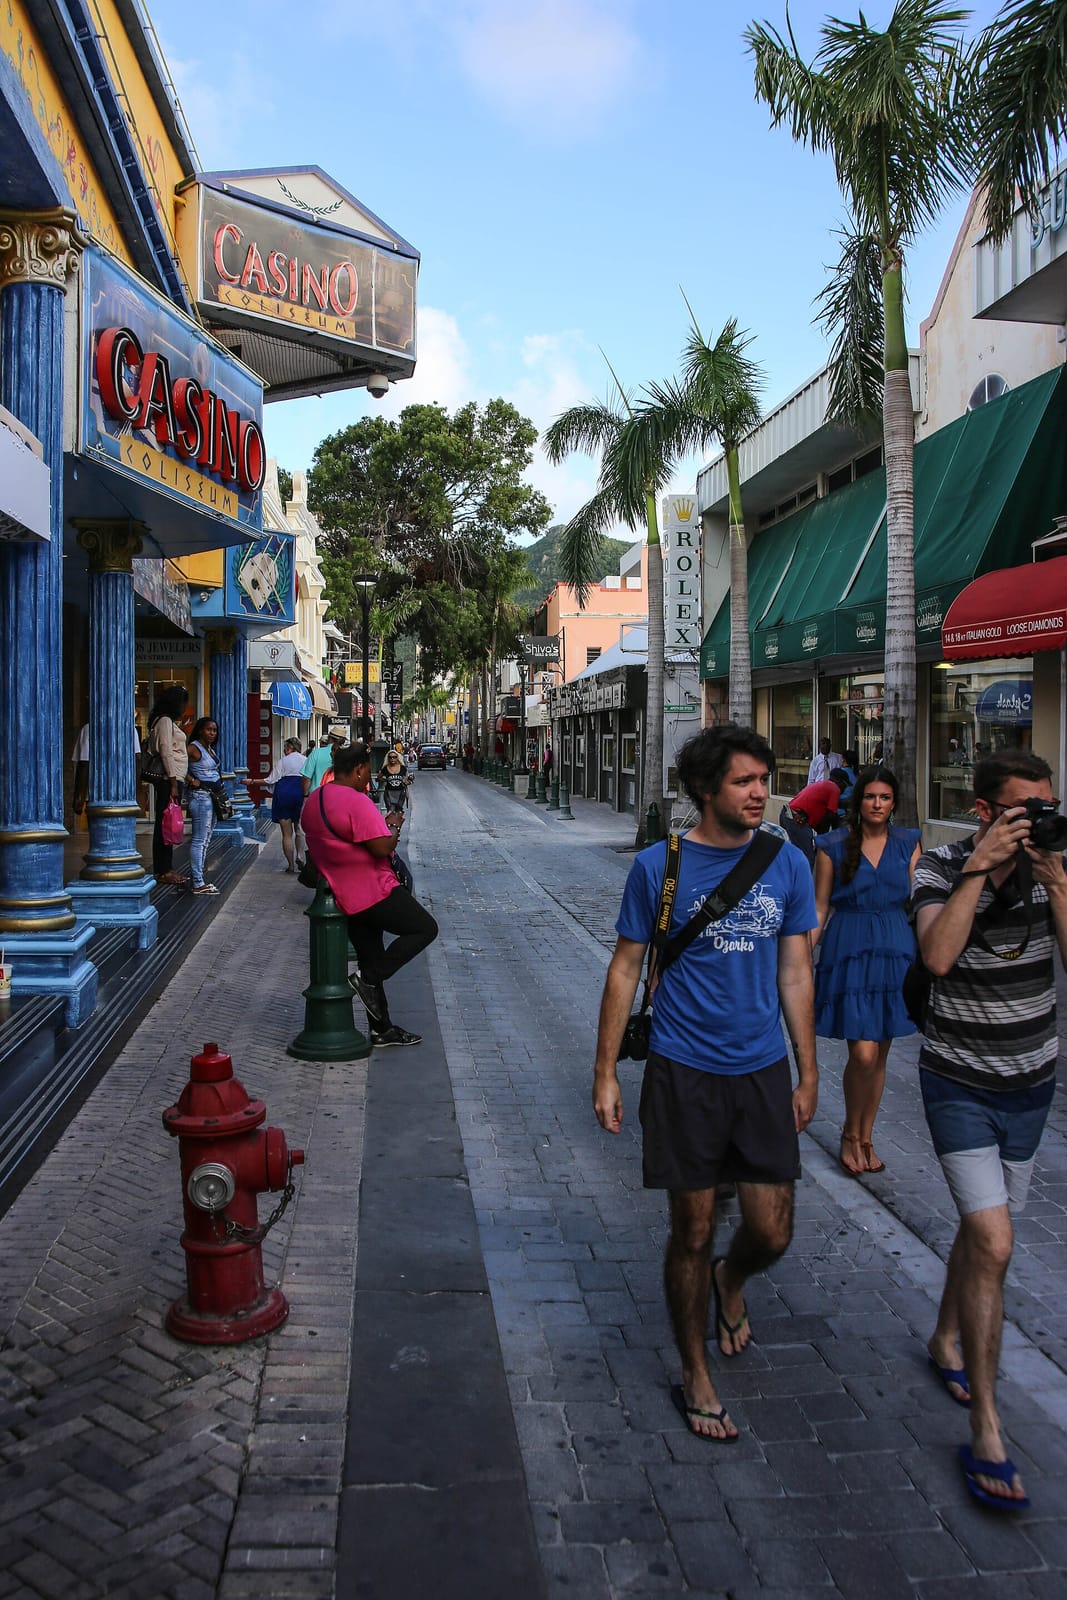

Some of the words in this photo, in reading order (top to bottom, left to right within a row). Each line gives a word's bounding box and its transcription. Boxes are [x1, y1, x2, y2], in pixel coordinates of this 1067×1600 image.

[214, 223, 359, 317] CASINO
[224, 290, 347, 334] COLISEUM
[97, 327, 267, 492] CASINO
[126, 444, 232, 513] COLISEUM
[675, 531, 693, 644] ROLEX
[966, 629, 986, 640] ITALIAN
[986, 626, 1002, 638] GOLD
[1006, 623, 1028, 636] LOOSE
[1028, 616, 1064, 633] DIAMONDS
[148, 641, 201, 653] JEWELERS
[662, 878, 676, 904] D750
[659, 906, 671, 931] Nikon
[713, 935, 755, 953] Ozarks
